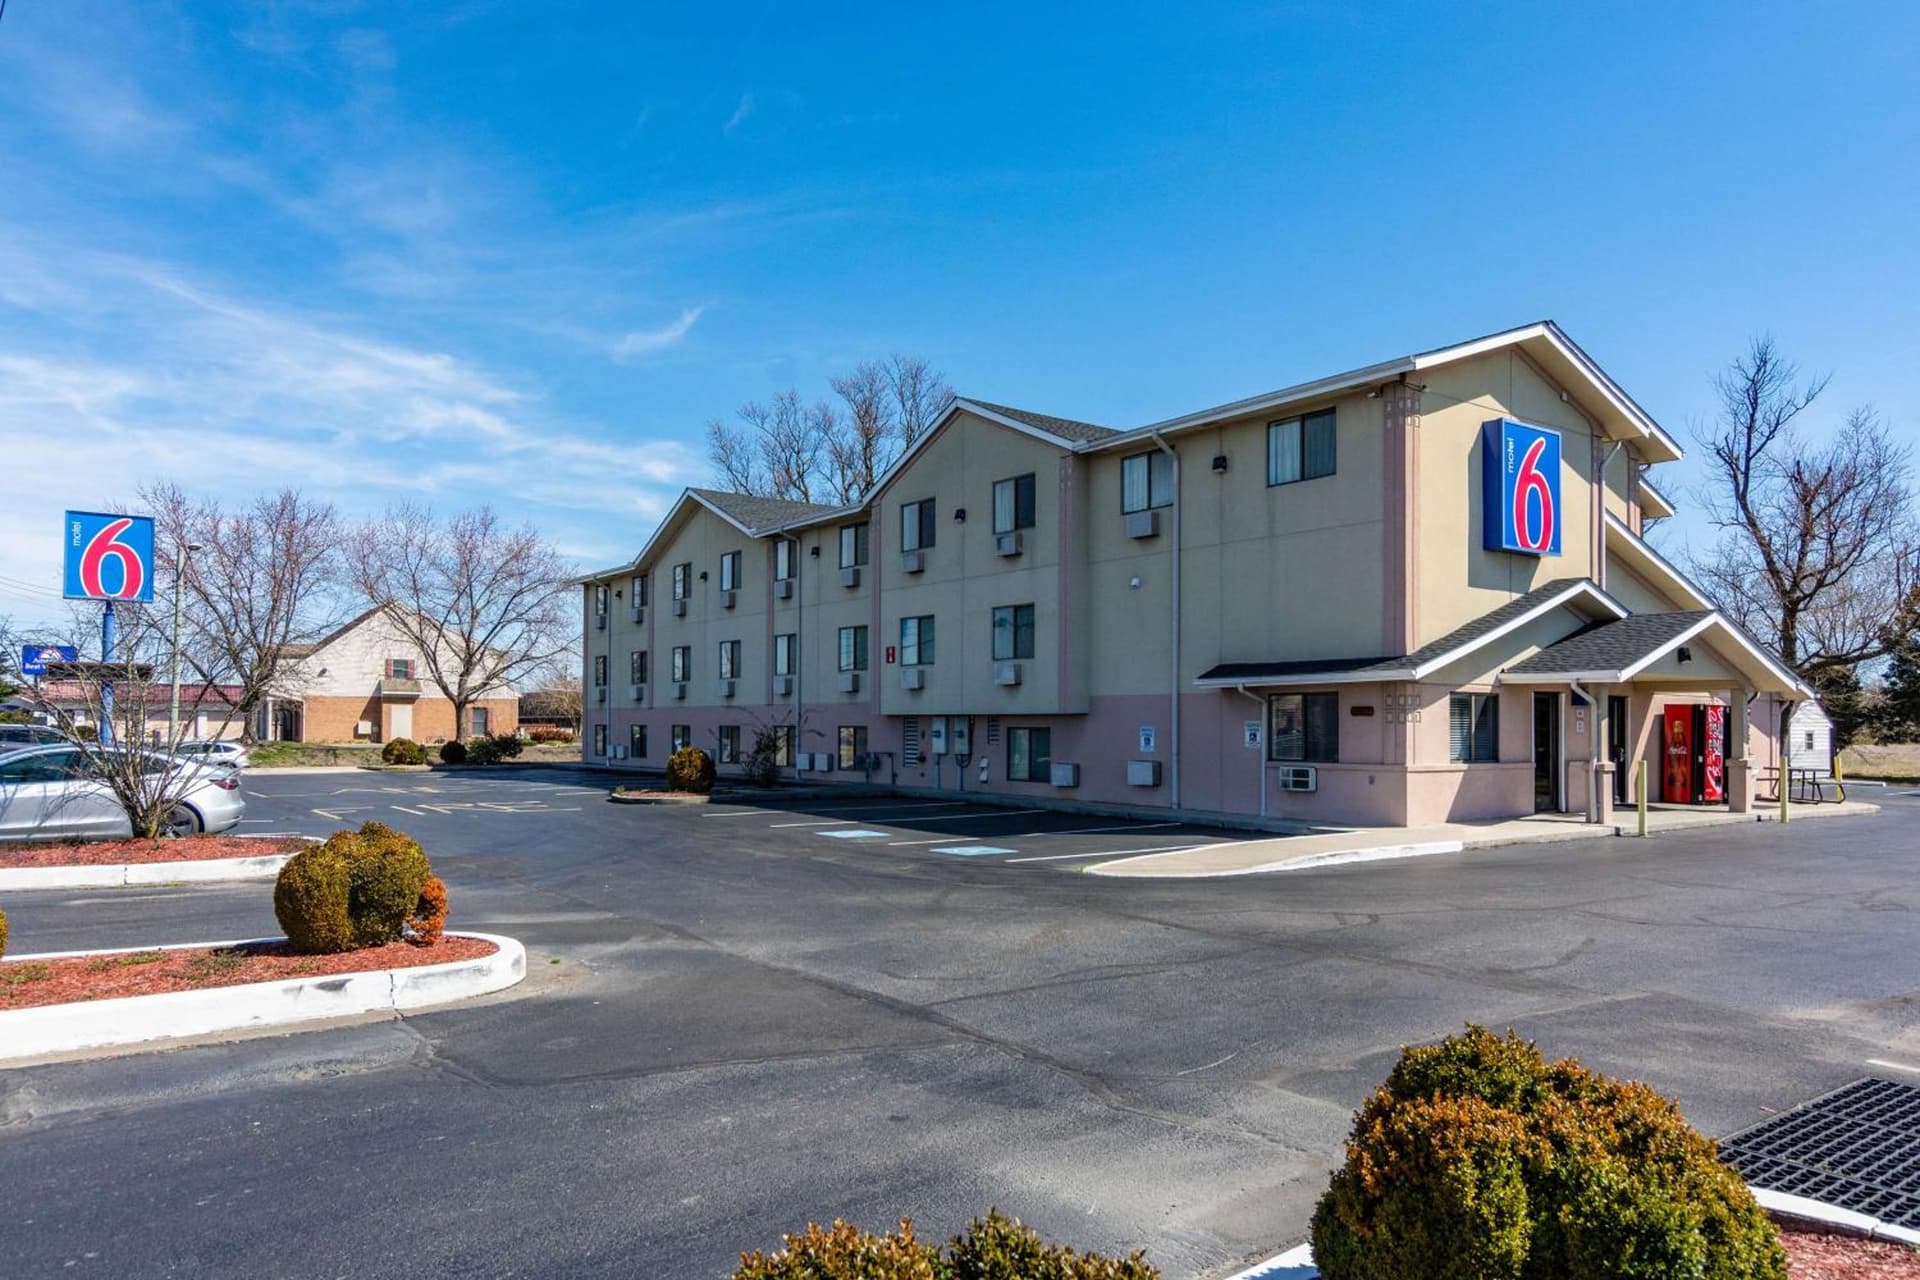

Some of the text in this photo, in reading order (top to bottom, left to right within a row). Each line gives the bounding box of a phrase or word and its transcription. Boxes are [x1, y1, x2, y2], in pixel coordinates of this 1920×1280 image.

[1507, 437, 1554, 552] motel 6
[72, 518, 144, 600] motel 6
